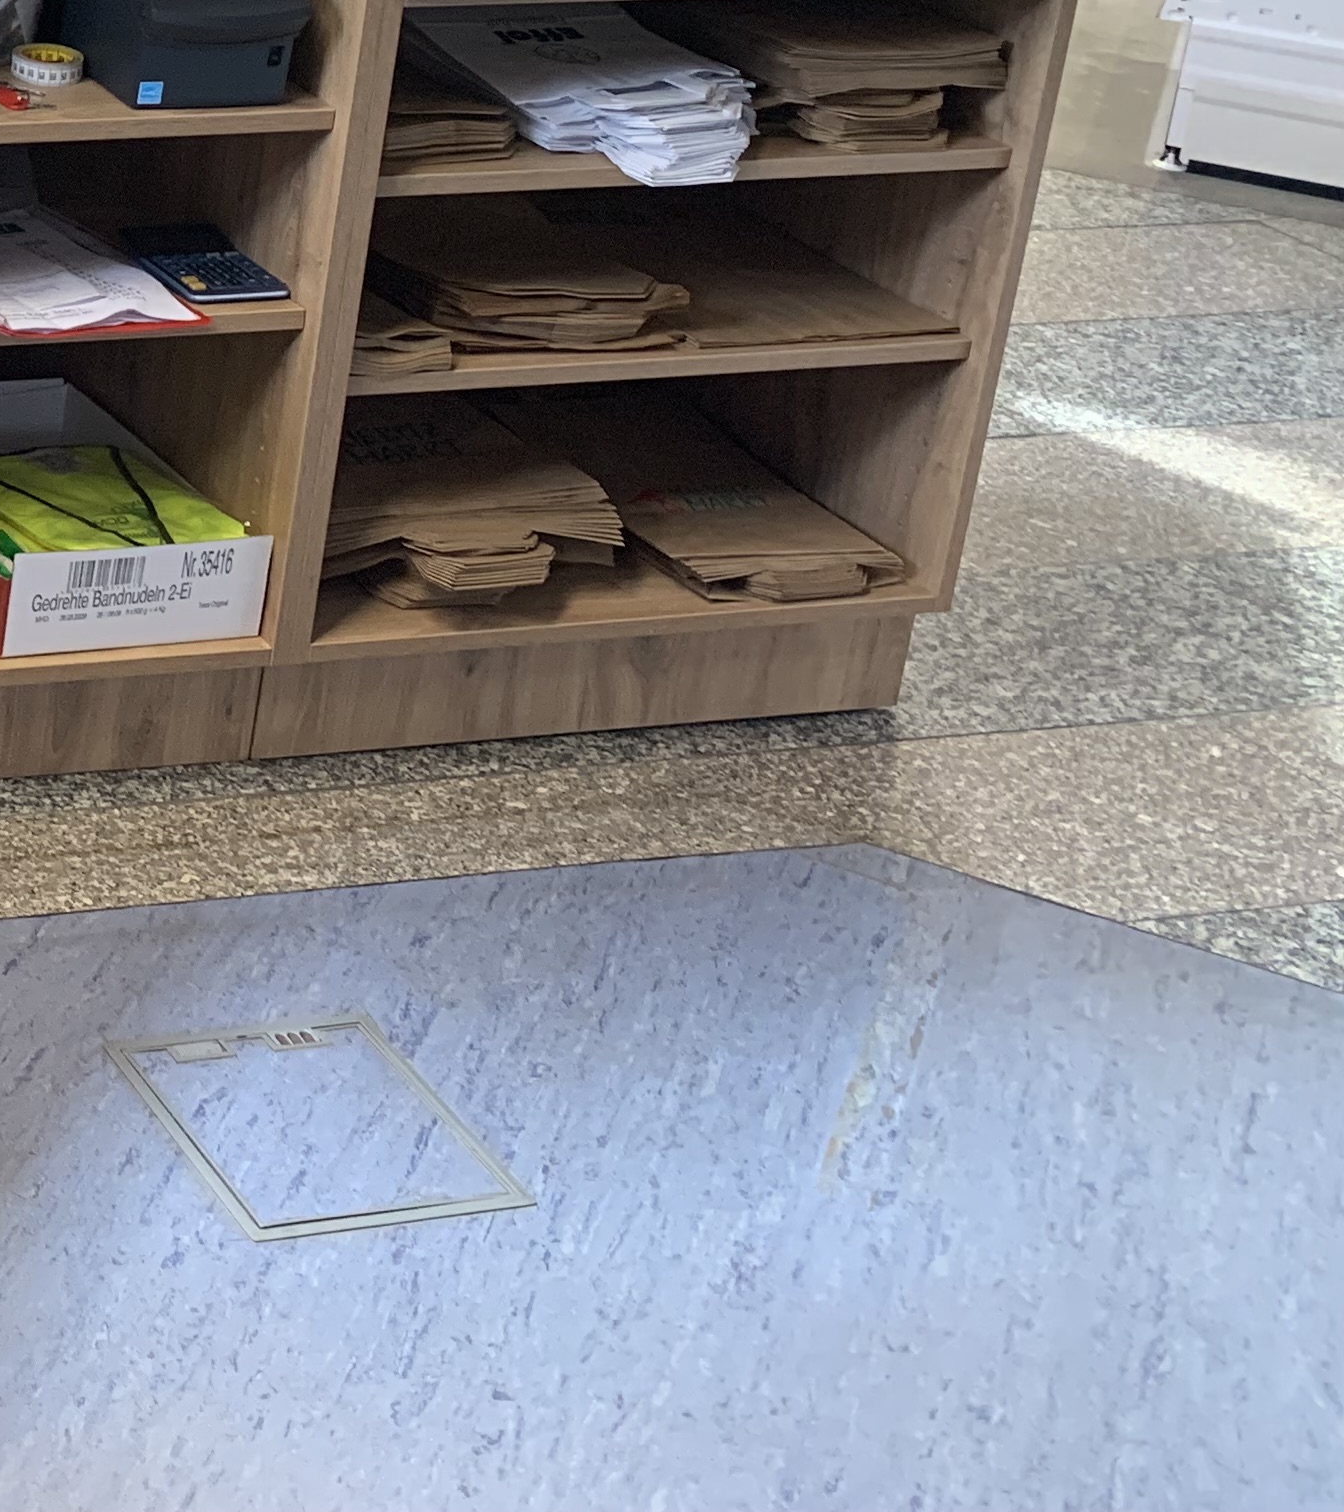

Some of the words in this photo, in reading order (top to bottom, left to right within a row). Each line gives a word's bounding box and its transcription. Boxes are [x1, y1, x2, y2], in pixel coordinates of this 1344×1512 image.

[198, 547, 234, 578] 35416
[31, 590, 90, 613] Gedrehte
[92, 585, 166, 608] Bandnudeln
[167, 582, 193, 601] 2-Ei
